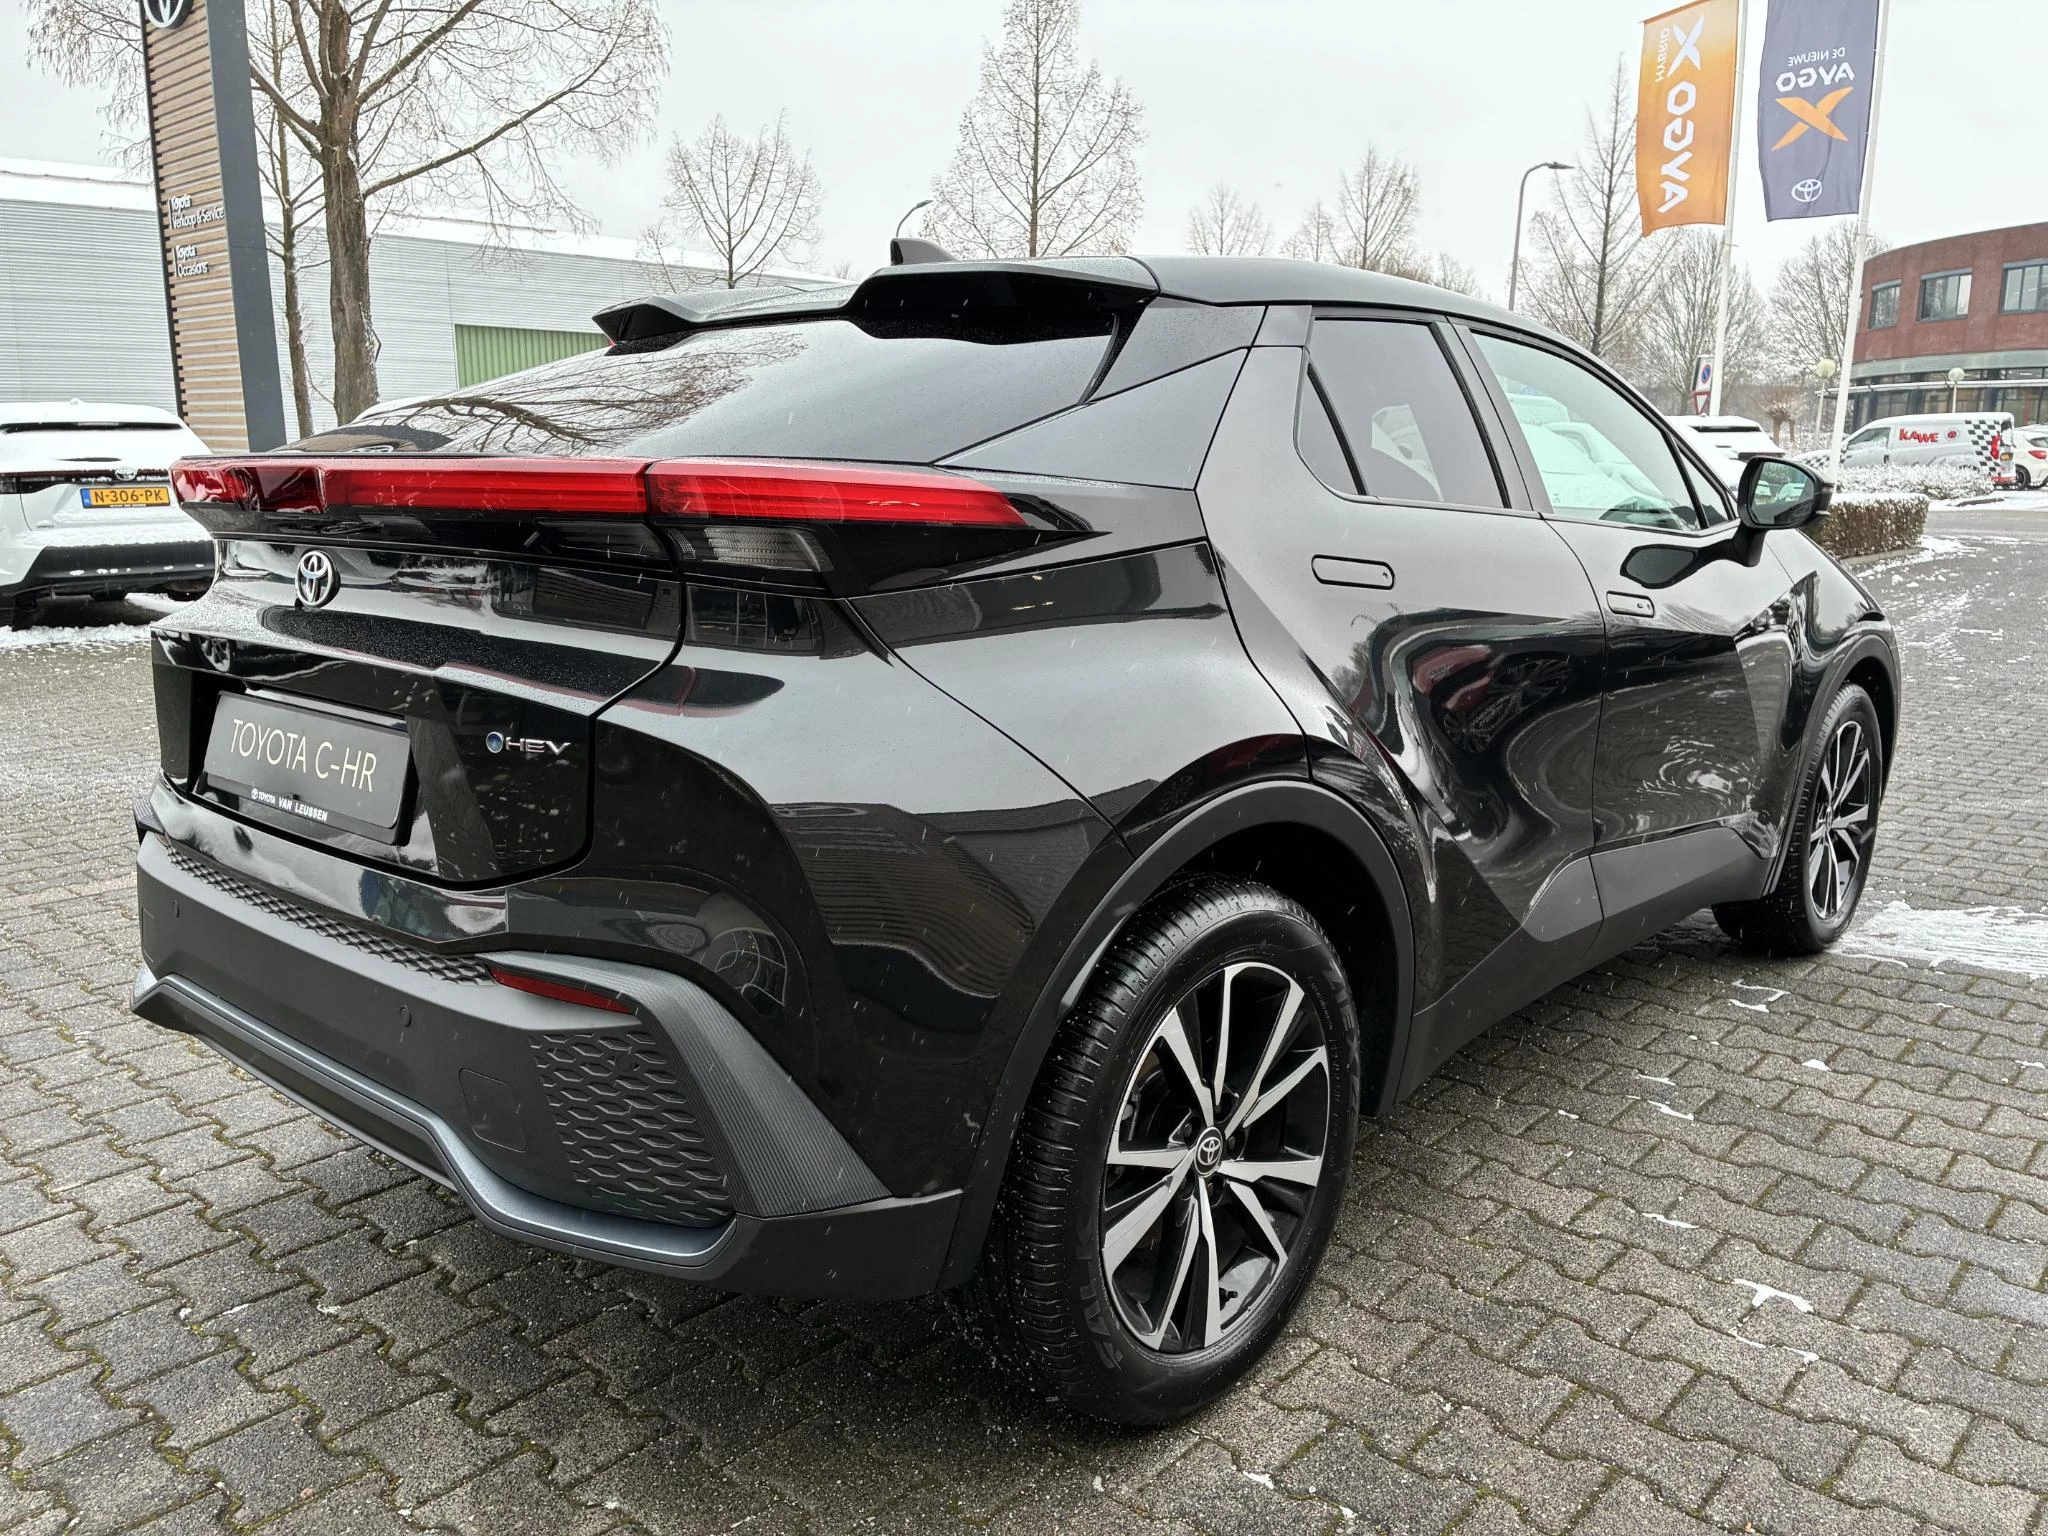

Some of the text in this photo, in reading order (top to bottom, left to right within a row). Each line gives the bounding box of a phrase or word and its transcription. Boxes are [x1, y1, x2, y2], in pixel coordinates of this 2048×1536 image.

[172, 194, 191, 213] Toyota
[172, 211, 197, 229] Verkoop
[201, 206, 225, 223] Service
[176, 245, 196, 262] Toyota
[178, 262, 209, 277] Occasions
[1899, 428, 1939, 444] KAWE
[94, 489, 164, 504] N-306-PK
[231, 718, 377, 793] TOYOTA C-HR
[505, 736, 572, 756] HEV
[258, 790, 328, 822] TOYOTA VAN LEUSSEN
